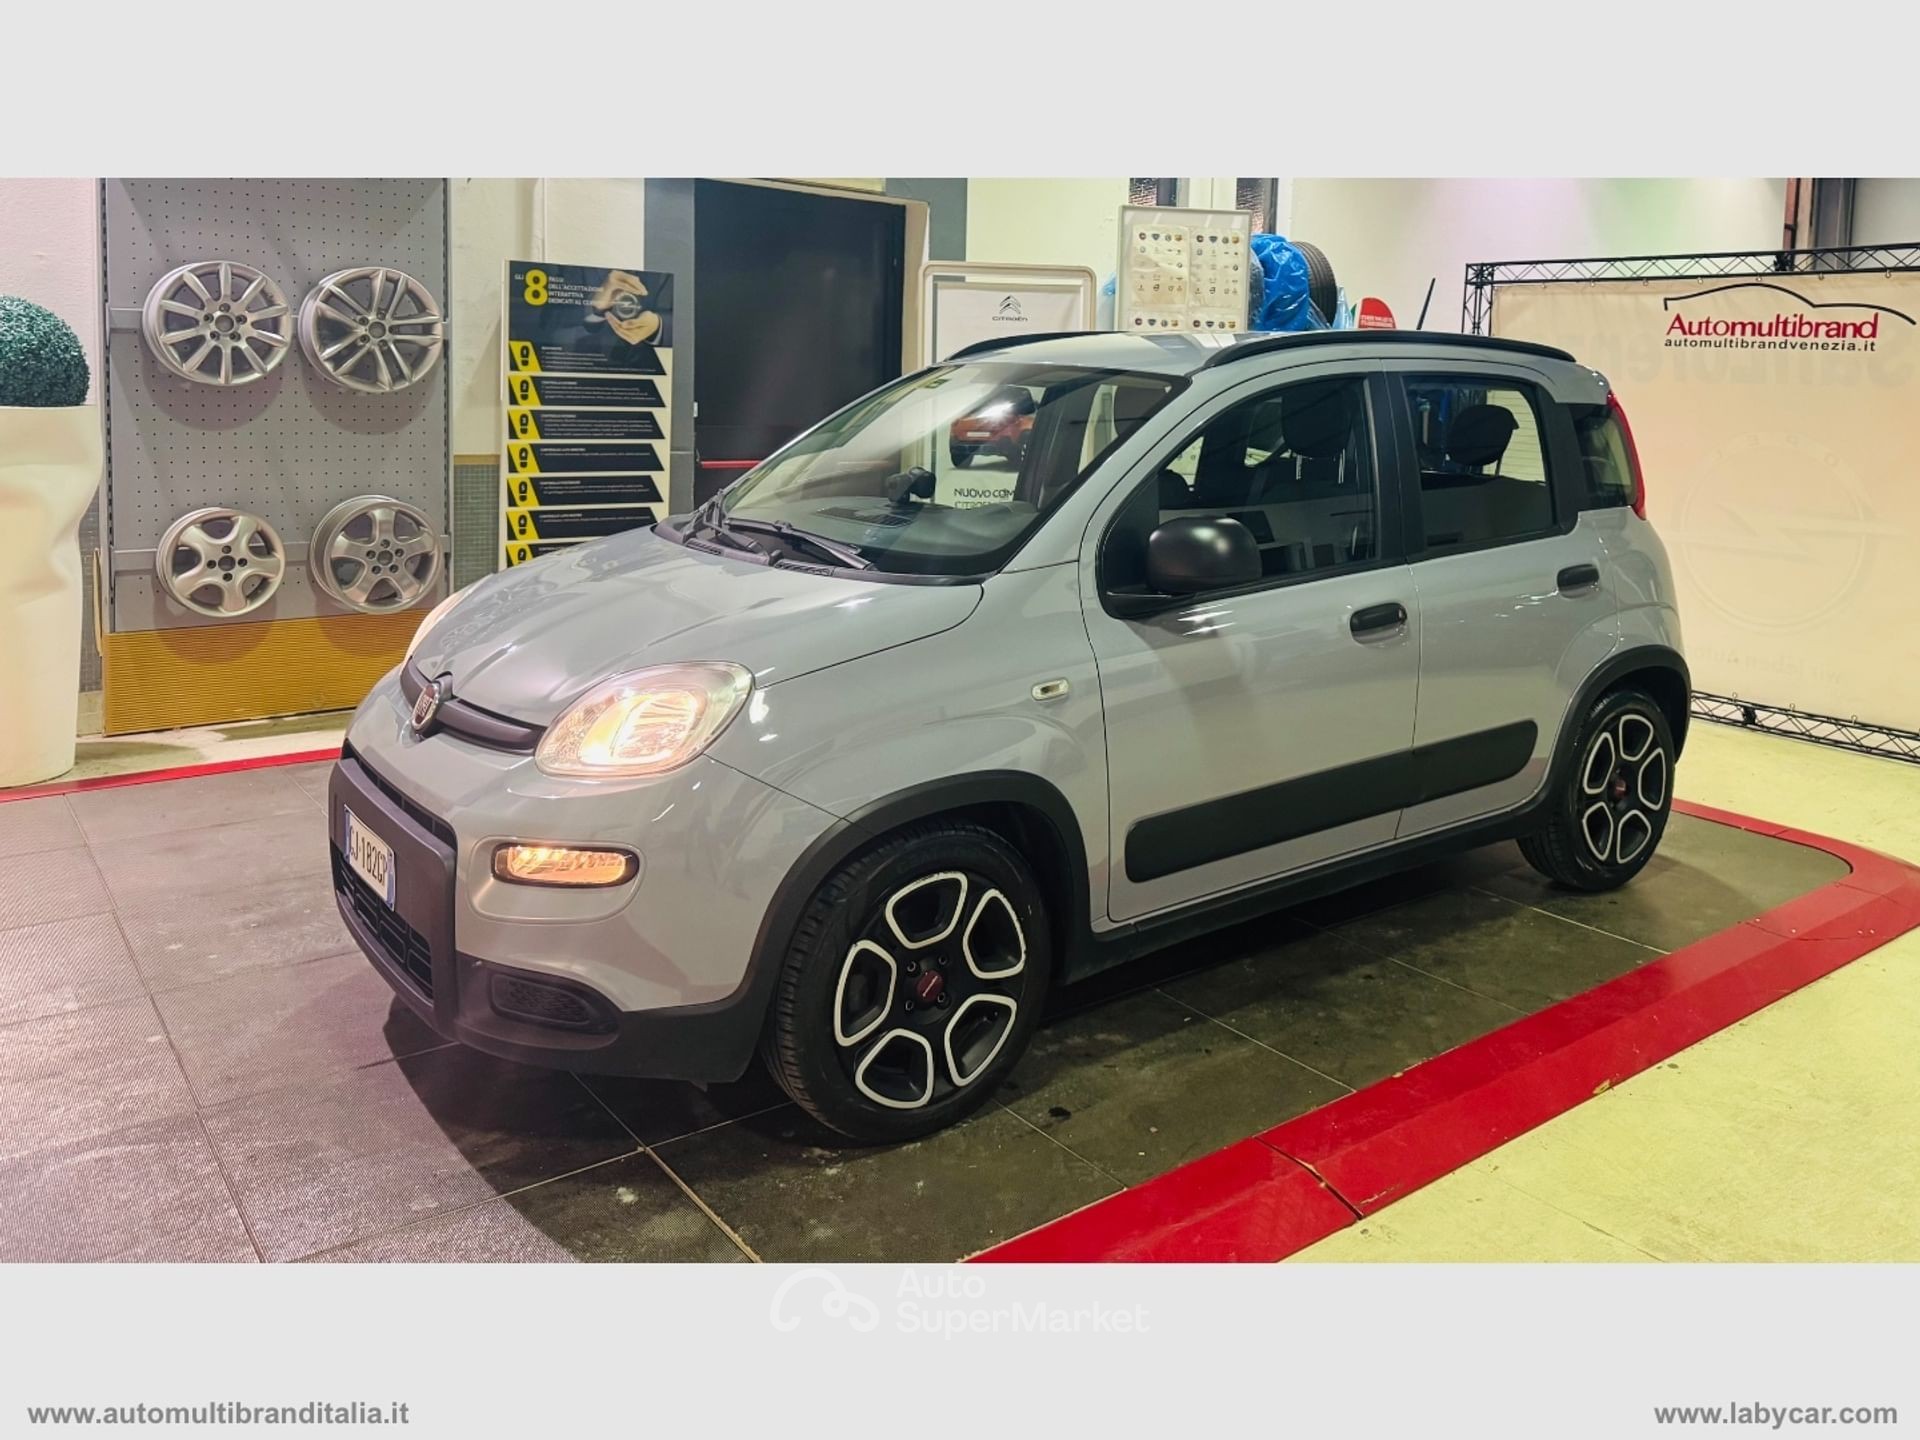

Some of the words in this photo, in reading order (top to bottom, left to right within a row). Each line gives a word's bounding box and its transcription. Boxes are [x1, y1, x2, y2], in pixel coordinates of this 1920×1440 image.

[524, 269, 548, 305] 8
[1665, 312, 1879, 340] Automultibrand
[1664, 338, 1876, 352] automultibrandvenezia.it
[953, 487, 992, 499] NUOVO
